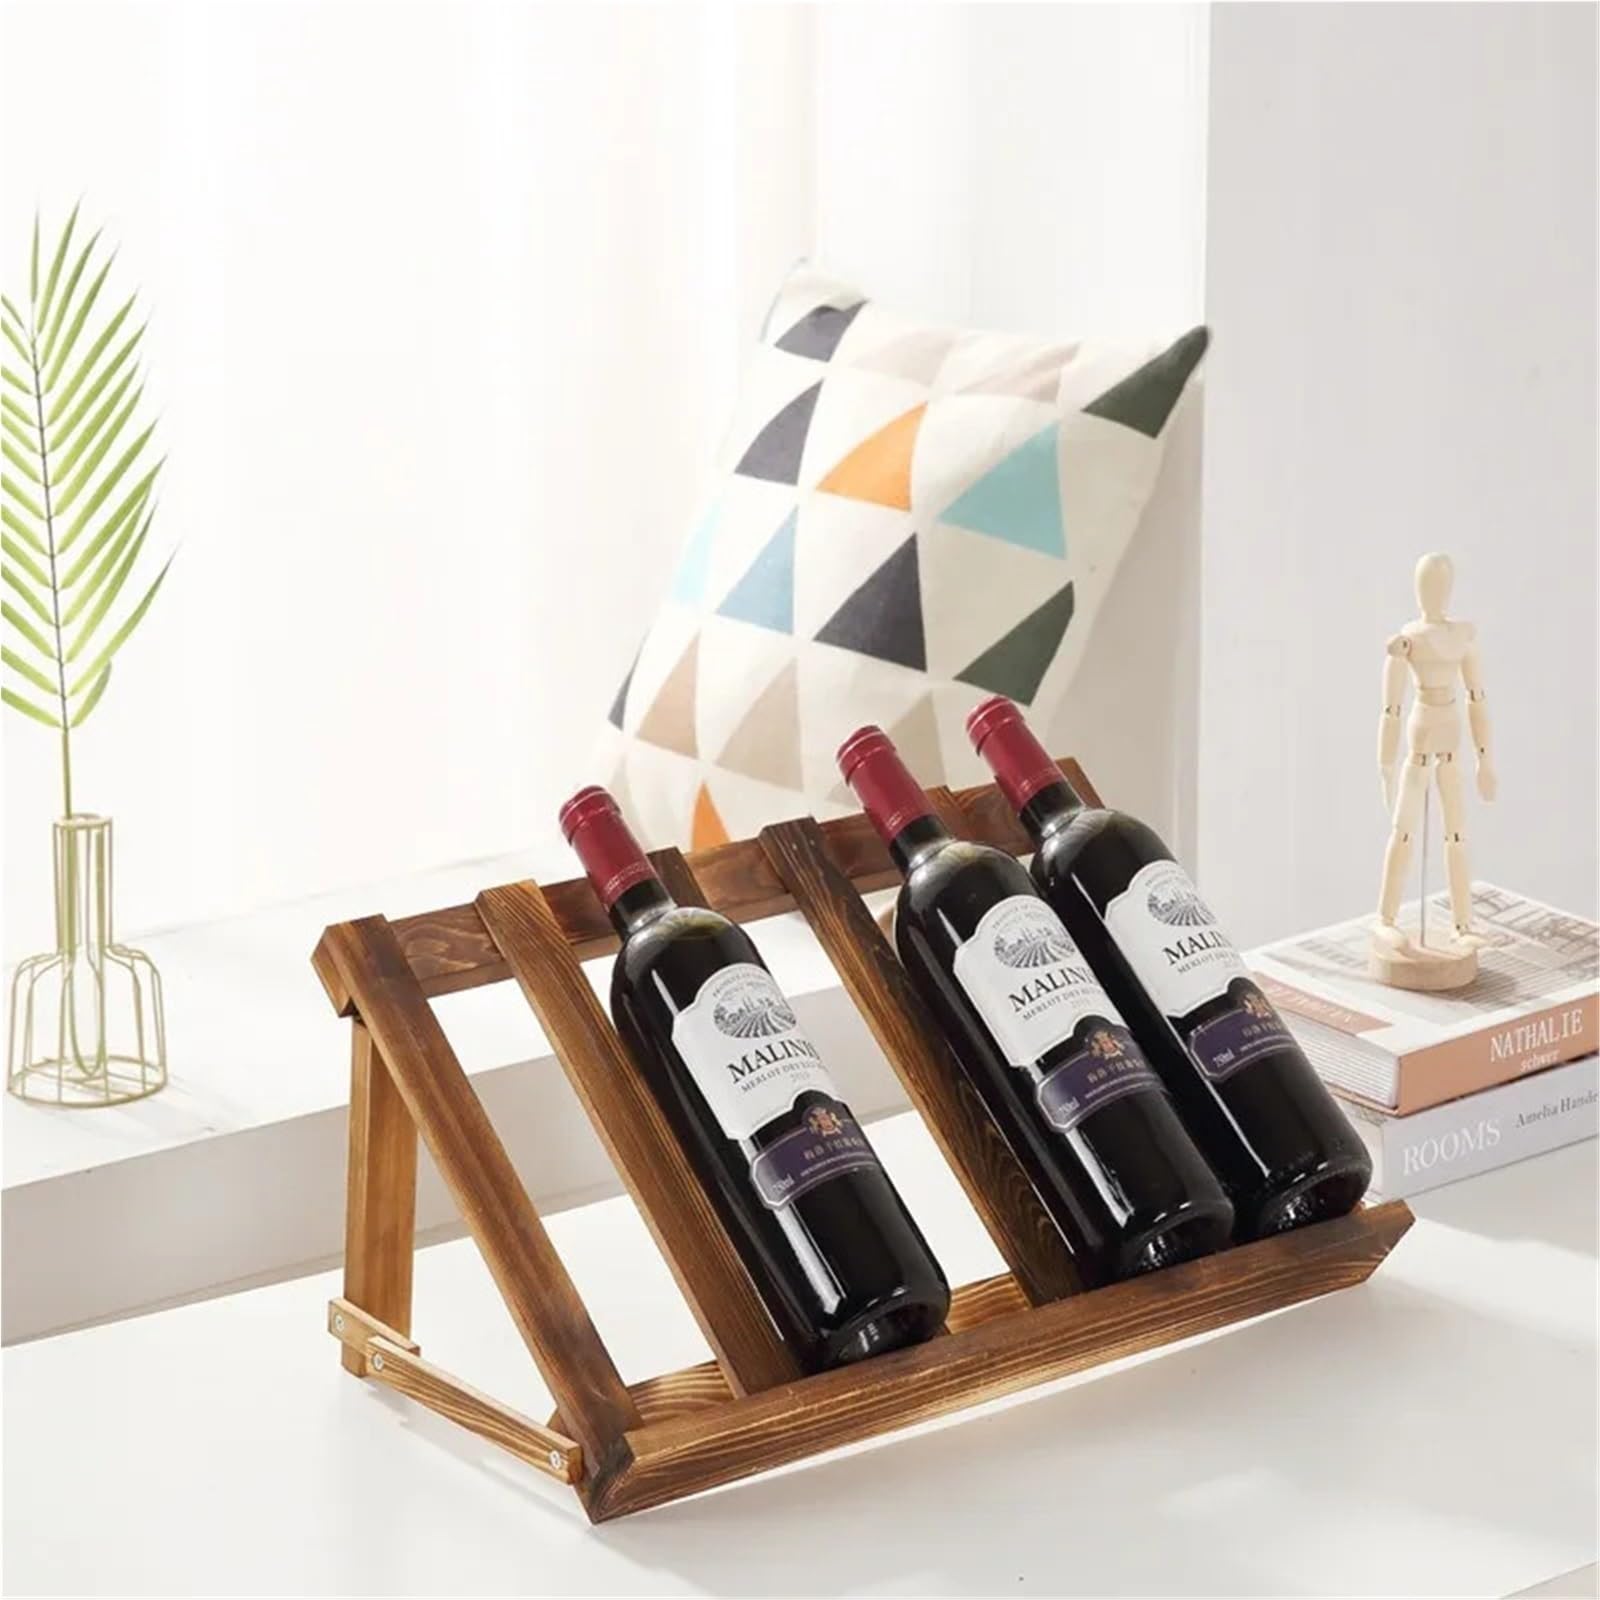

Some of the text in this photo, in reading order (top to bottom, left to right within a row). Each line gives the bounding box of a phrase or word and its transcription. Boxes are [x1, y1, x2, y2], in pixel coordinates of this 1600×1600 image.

[1023, 995, 1061, 1021] MERLOT
[1490, 1008, 1584, 1063] NATHALIE
[741, 1067, 781, 1093] MERLOT
[1403, 1118, 1501, 1177] ROOMS
[1515, 1103, 1558, 1129] Amelia
